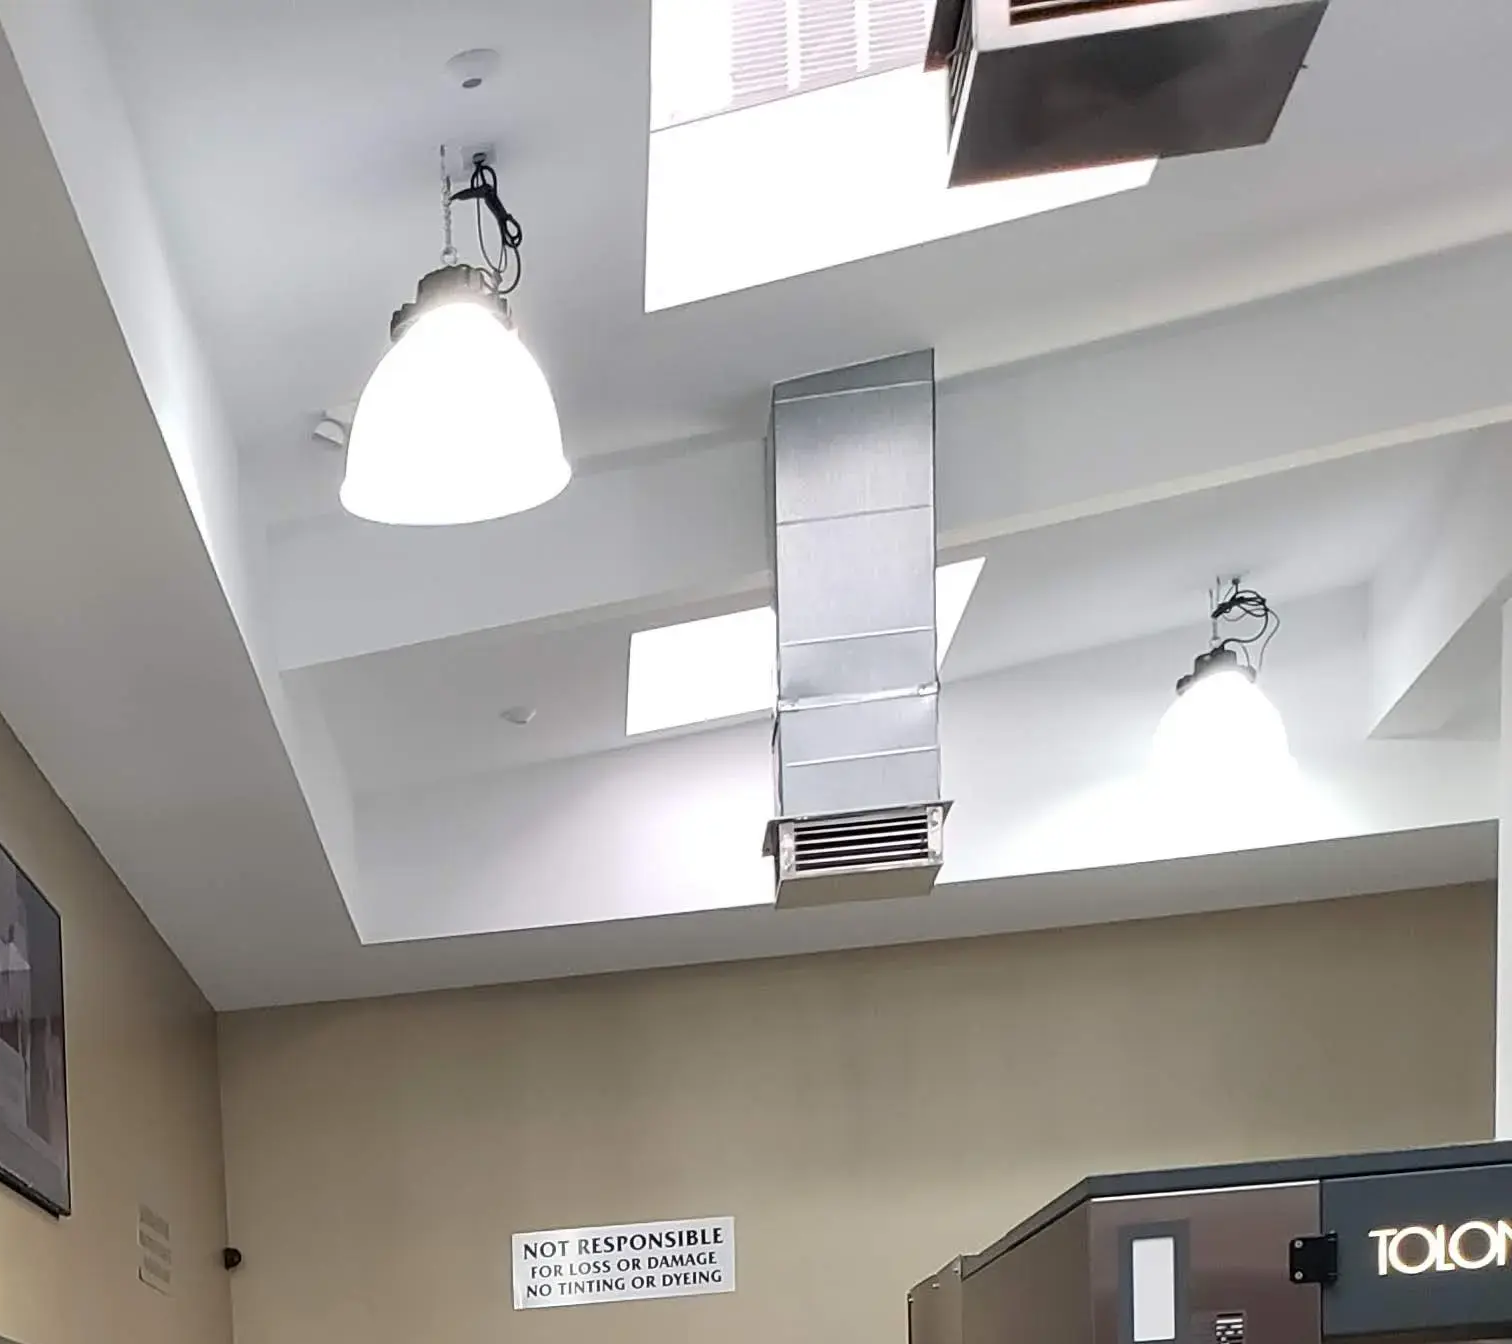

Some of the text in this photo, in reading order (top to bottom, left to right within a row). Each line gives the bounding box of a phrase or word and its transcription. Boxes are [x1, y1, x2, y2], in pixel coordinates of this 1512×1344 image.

[524, 1227, 724, 1260] NOT RESPONSIBLE
[531, 1251, 717, 1279] FOR LOSS OR DAMAGE
[527, 1269, 722, 1298] NO TINTING OR DYEING
